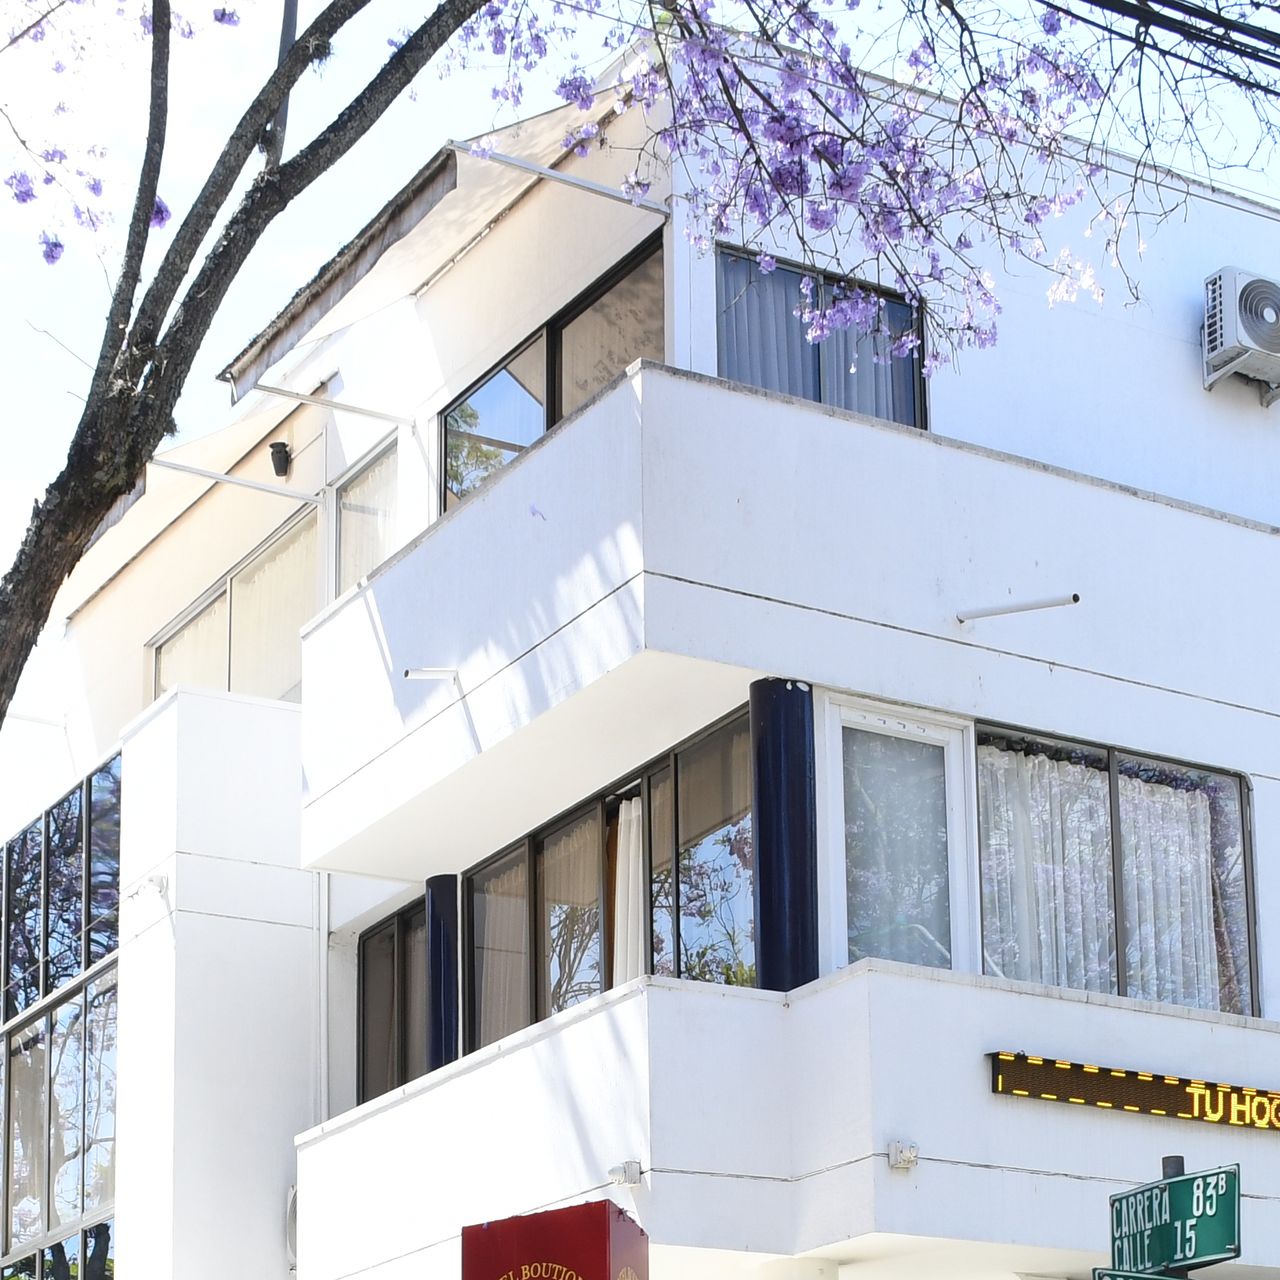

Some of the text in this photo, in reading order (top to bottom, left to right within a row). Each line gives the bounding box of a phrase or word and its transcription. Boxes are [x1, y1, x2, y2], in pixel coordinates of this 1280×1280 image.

[1185, 1087, 1224, 1121] TU
[1113, 1173, 1227, 1238] CARRERA 83B
[1114, 1218, 1197, 1271] CALLE 15
